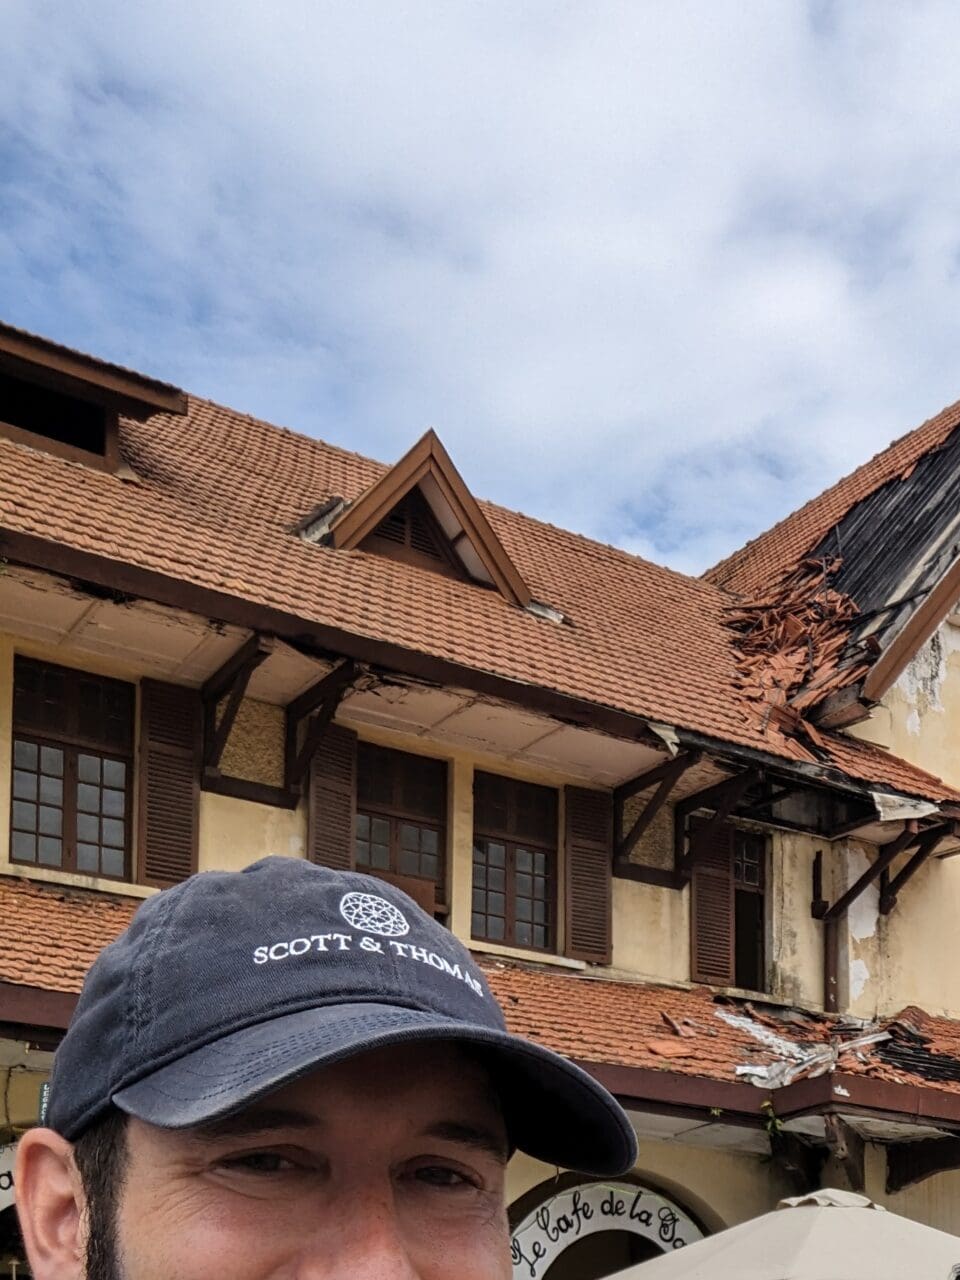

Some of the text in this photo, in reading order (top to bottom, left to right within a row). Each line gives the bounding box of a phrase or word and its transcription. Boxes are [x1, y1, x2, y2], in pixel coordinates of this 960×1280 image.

[253, 933, 484, 997] SCOTT & THOMAS
[600, 1191, 626, 1217] de
[630, 1190, 653, 1227] la
